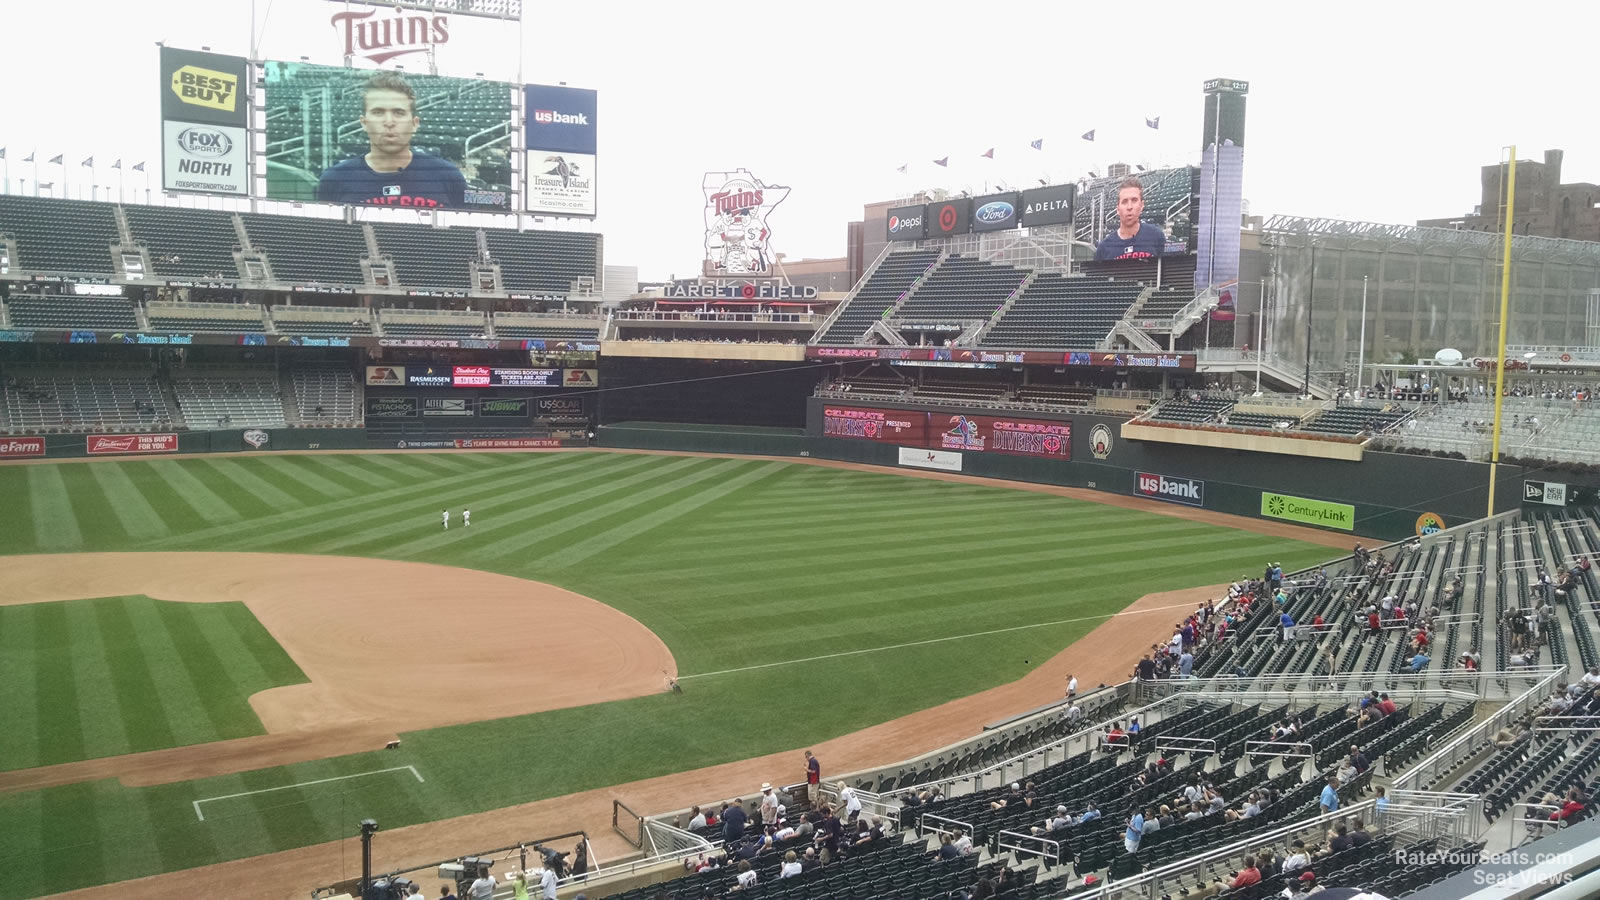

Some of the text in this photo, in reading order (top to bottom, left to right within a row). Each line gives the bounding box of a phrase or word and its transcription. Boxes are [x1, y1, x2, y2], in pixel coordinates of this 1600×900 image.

[331, 6, 449, 58] Twins
[180, 71, 236, 93] BEST
[181, 85, 230, 104] BUY
[189, 132, 221, 147] FOX
[189, 145, 222, 153] SPORTS
[178, 159, 233, 176] NORTH
[175, 180, 237, 191] FOXSPORTSNORTH.COM
[534, 175, 589, 189] Treasure Island
[540, 200, 584, 208] ticasino.com
[709, 188, 764, 216] Twins
[1035, 200, 1069, 212] DELTA
[983, 205, 1006, 220] Ford
[900, 215, 923, 229] pepsi
[664, 285, 818, 298] TARGET FIELD
[136, 333, 193, 344] Treasure Island
[379, 339, 459, 347] CELEBRATE
[818, 348, 877, 357] CELEBRATE
[1127, 355, 1182, 367] Treasure Island
[477, 367, 489, 375] Day
[371, 403, 413, 411] PISTACHIOS
[482, 401, 526, 411] SUBWAY
[824, 408, 885, 420] CELEBRATE
[824, 416, 885, 438] DIVERSITY
[886, 420, 911, 428] PRESENTED
[993, 421, 1070, 435] CELEBRATE
[255, 434, 267, 442] 29
[993, 430, 1070, 455] DIVERSITY
[9, 441, 40, 451] Farm
[1139, 474, 1200, 499] usbank
[1546, 493, 1562, 501] ERA
[1288, 503, 1346, 522] CenturyLink
